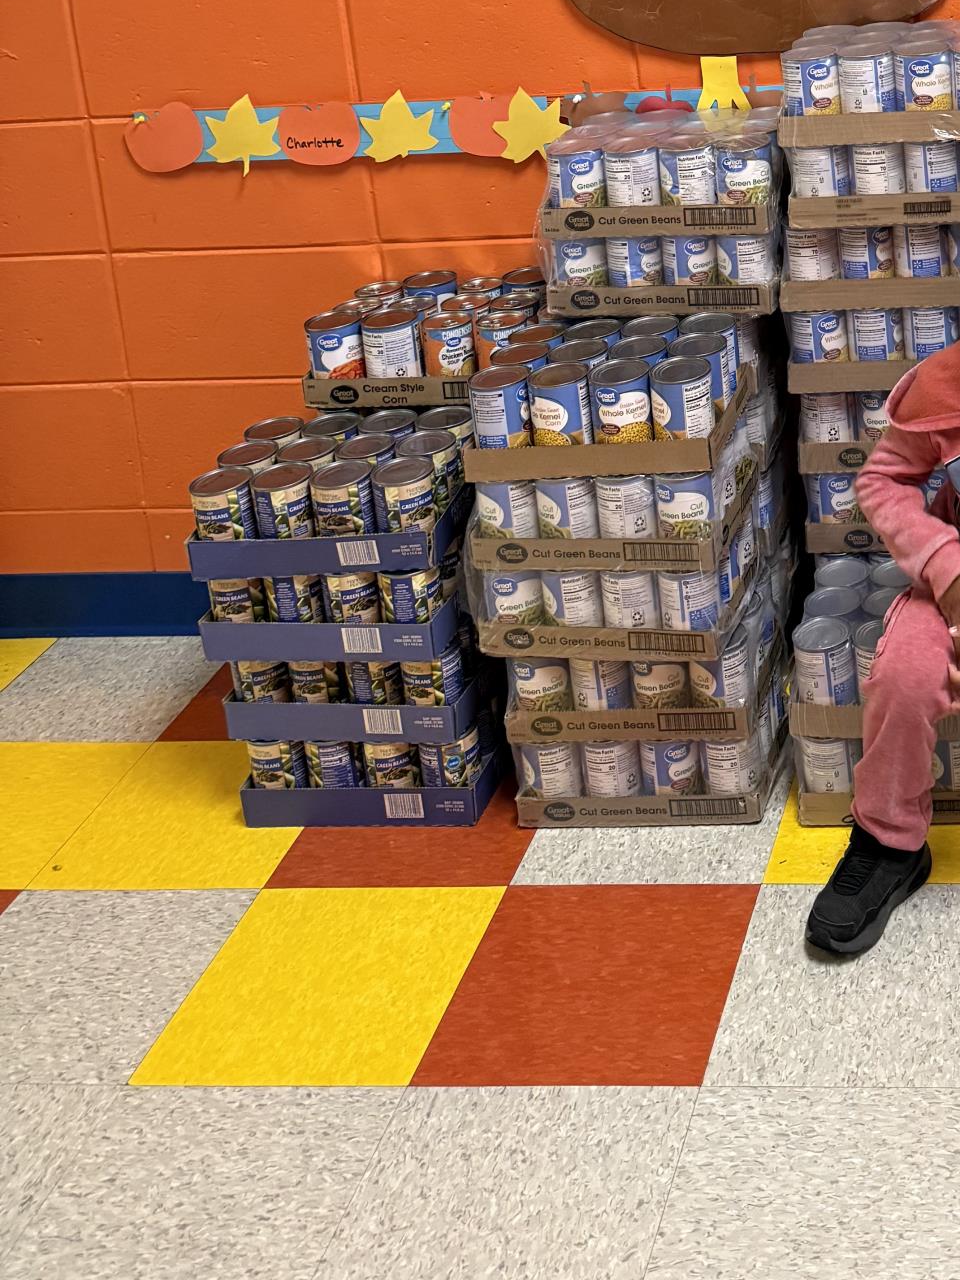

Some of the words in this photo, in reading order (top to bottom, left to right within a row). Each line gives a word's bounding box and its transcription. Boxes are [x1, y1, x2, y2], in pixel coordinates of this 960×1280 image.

[814, 82, 834, 91] Whole
[286, 136, 345, 150] Charlotte
[598, 216, 616, 225] Cut
[618, 216, 649, 225] Green
[650, 216, 682, 224] Beans
[604, 296, 620, 305] Cut
[623, 296, 654, 305] Green
[656, 296, 686, 304] Beans
[400, 384, 424, 393] Style
[332, 389, 354, 398] Great
[597, 392, 616, 400] Great
[382, 396, 408, 404] Corn
[402, 502, 417, 510] GREEN
[532, 549, 551, 558] Cut
[554, 550, 586, 559] Green
[588, 549, 621, 558] Beans
[538, 636, 558, 645] Cut
[560, 637, 592, 646] Green
[594, 638, 626, 648] Beans
[566, 722, 586, 730] Cut
[588, 721, 620, 730] Green
[623, 720, 656, 730] Beans
[667, 749, 686, 758] Great
[579, 807, 598, 816] Cut
[601, 808, 633, 816] Green
[636, 806, 668, 816] Beans
